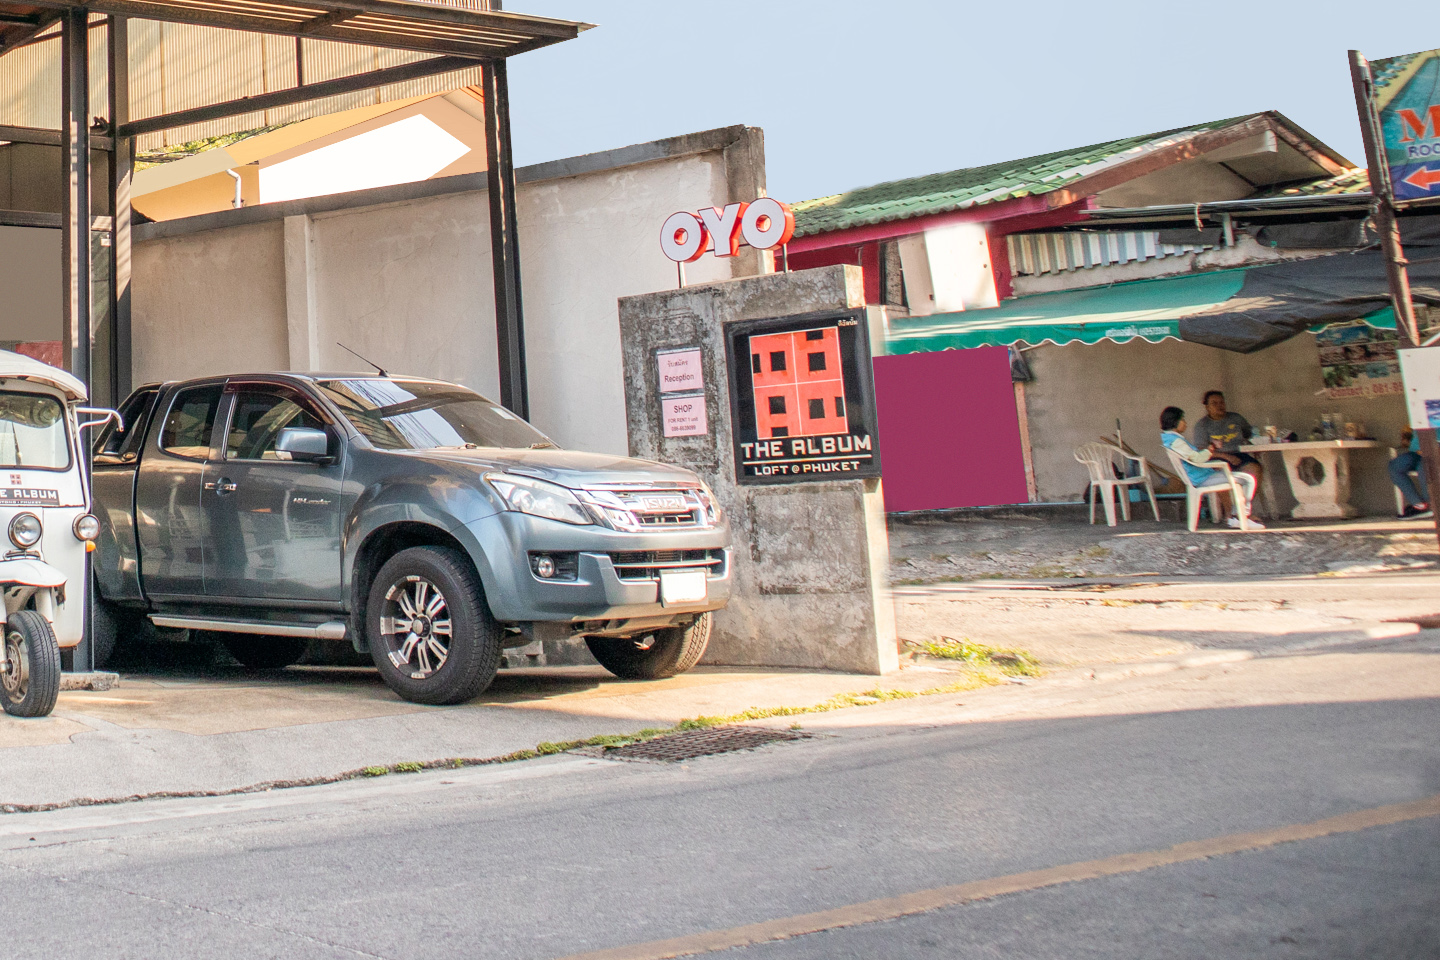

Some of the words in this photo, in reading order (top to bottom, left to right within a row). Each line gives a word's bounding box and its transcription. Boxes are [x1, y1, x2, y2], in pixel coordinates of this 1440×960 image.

[660, 197, 793, 263] OYO
[664, 372, 695, 383] Reception
[673, 404, 693, 414] SHOP
[740, 440, 784, 459] THE
[791, 434, 872, 456] ALBUM
[754, 465, 789, 476] LOFT
[791, 464, 800, 474] @
[803, 461, 860, 473] PHUKET
[14, 489, 58, 500] ALBUM
